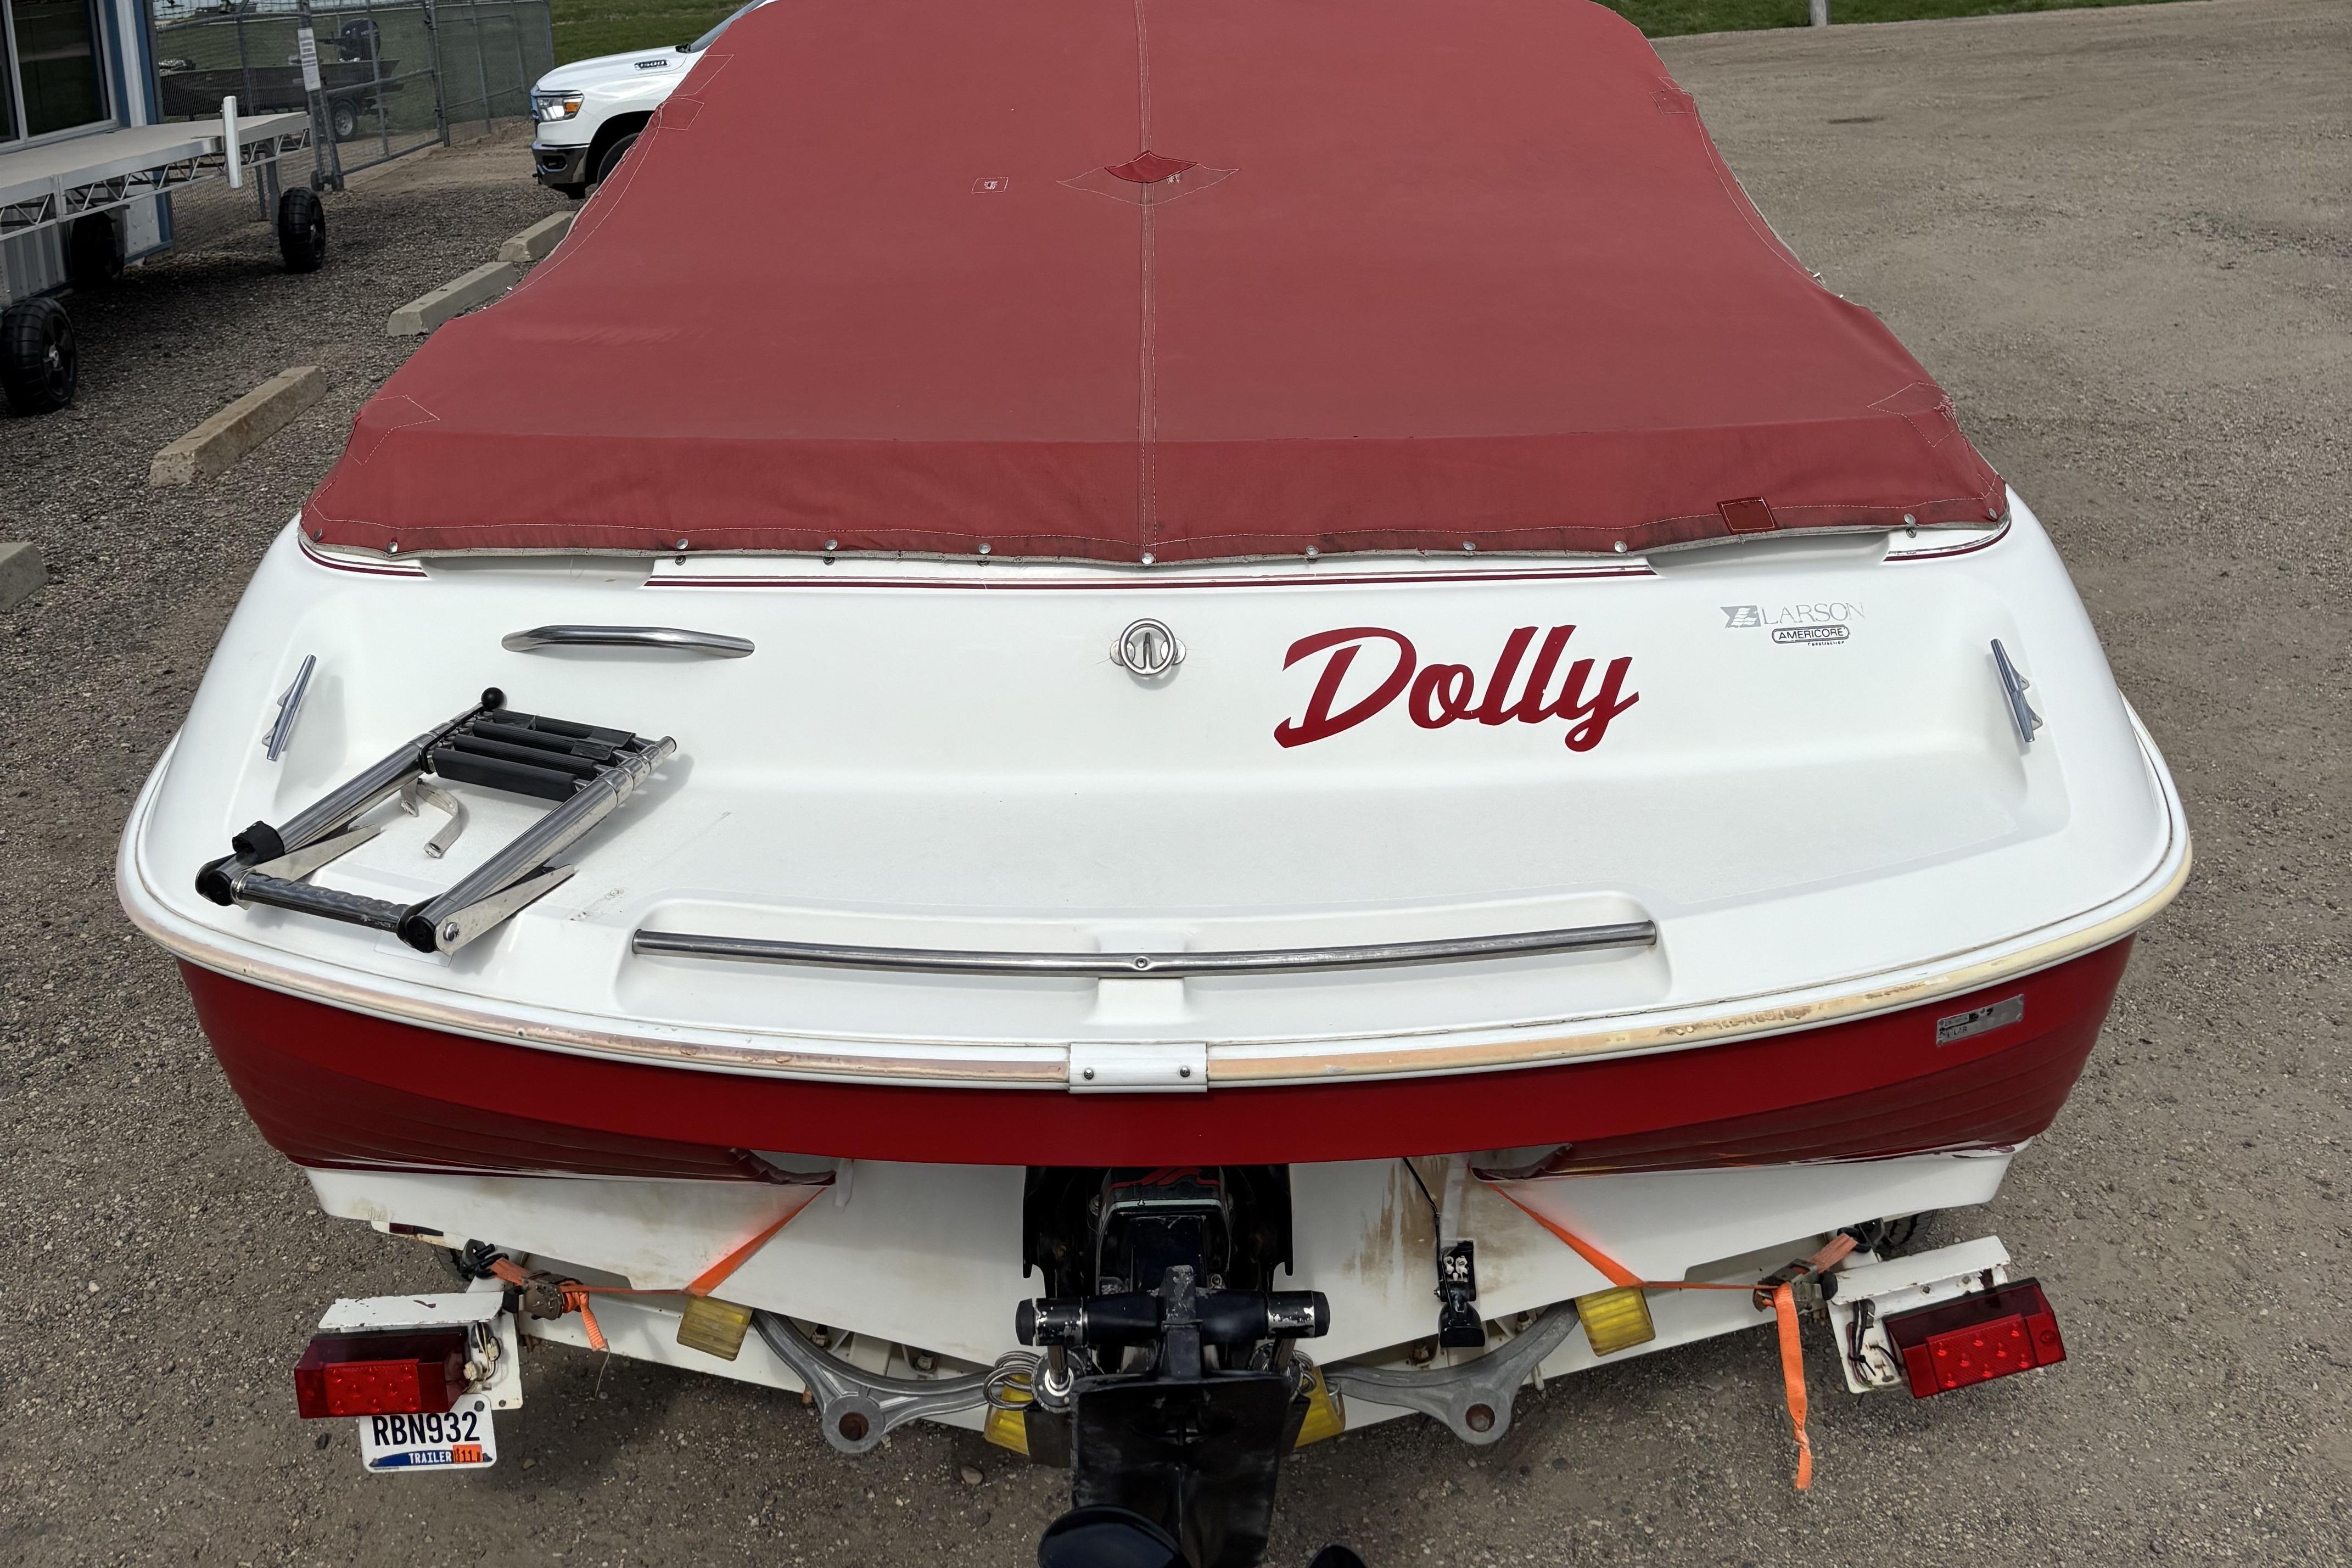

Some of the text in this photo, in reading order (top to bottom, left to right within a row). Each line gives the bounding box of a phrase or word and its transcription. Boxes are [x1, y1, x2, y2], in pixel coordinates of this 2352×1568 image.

[1762, 602, 1865, 625] LARSON
[1778, 628, 1844, 640] AMERICORE
[1274, 625, 1639, 752] Dolly
[372, 1411, 480, 1446] RBN932
[408, 1451, 452, 1464] TRAILER
